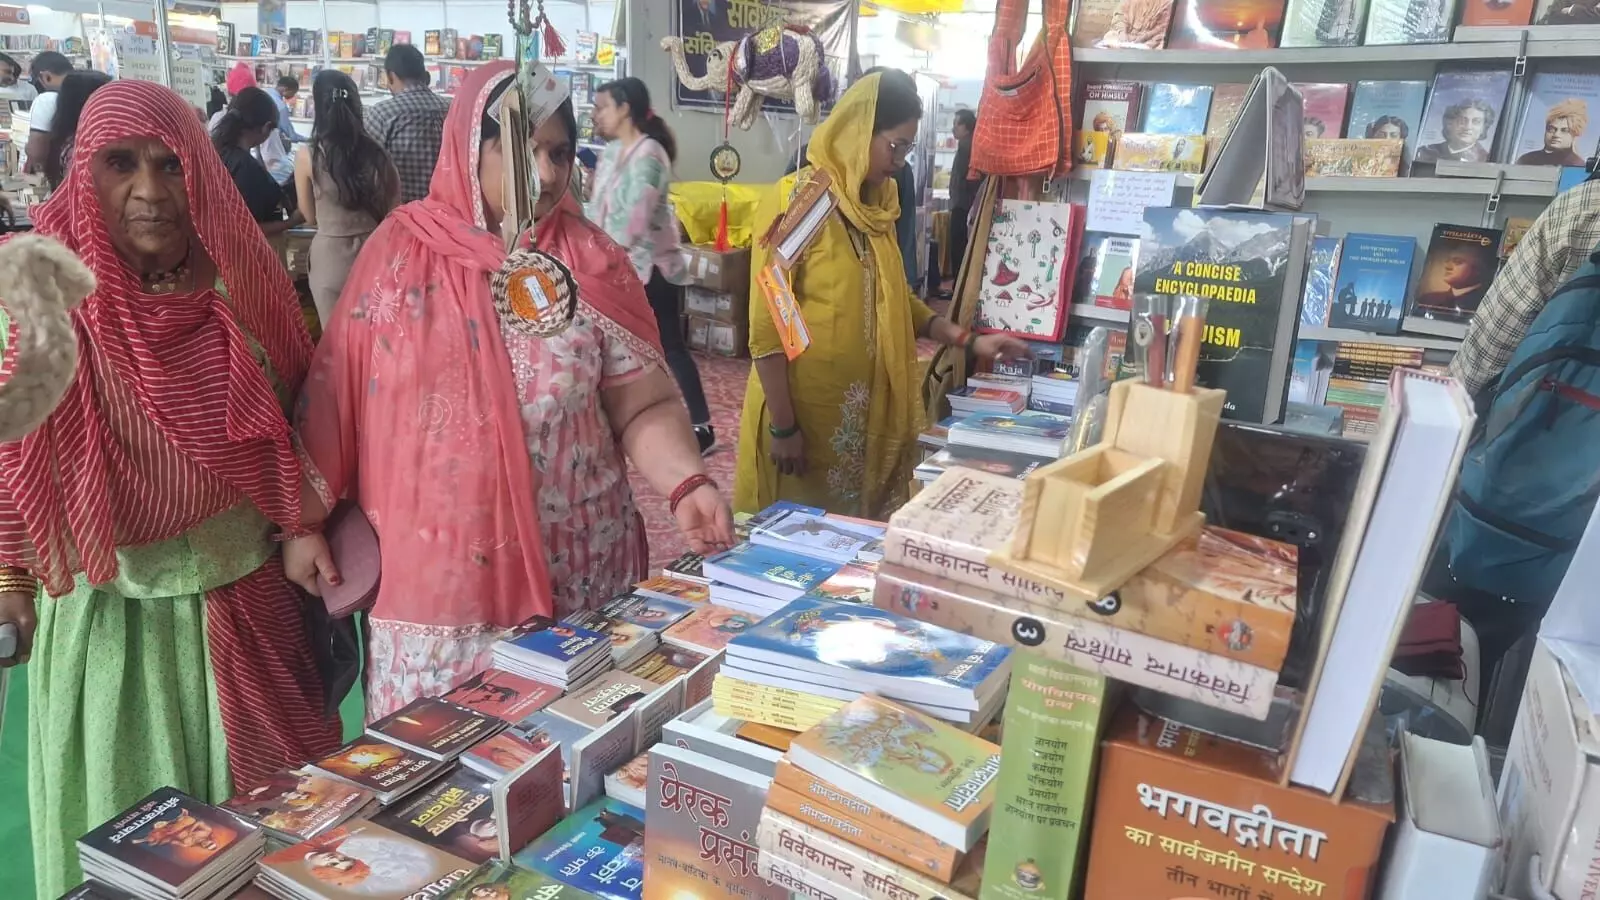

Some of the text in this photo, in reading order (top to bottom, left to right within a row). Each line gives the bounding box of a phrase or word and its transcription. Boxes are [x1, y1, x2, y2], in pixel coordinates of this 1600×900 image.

[1155, 278, 1256, 304] ENCYCLOPAEDIA
[1173, 261, 1241, 281] A CONCISE
[999, 364, 1023, 375] Raja
[903, 538, 991, 580] विवेकानन्द
[1016, 623, 1038, 640] 3
[1064, 634, 1250, 704] विवेकानन्द साहित्य
[411, 787, 466, 828] जीवन
[659, 761, 732, 828] प्रेरक
[427, 794, 490, 837] मरणोत्तर
[1136, 782, 1328, 861] भगवद्गीता
[559, 845, 607, 877] के प्रति
[779, 830, 855, 881] विवेकानन्द
[1124, 825, 1326, 897] का सार्वजनीन सन्देश
[1166, 865, 1199, 888] तीन
